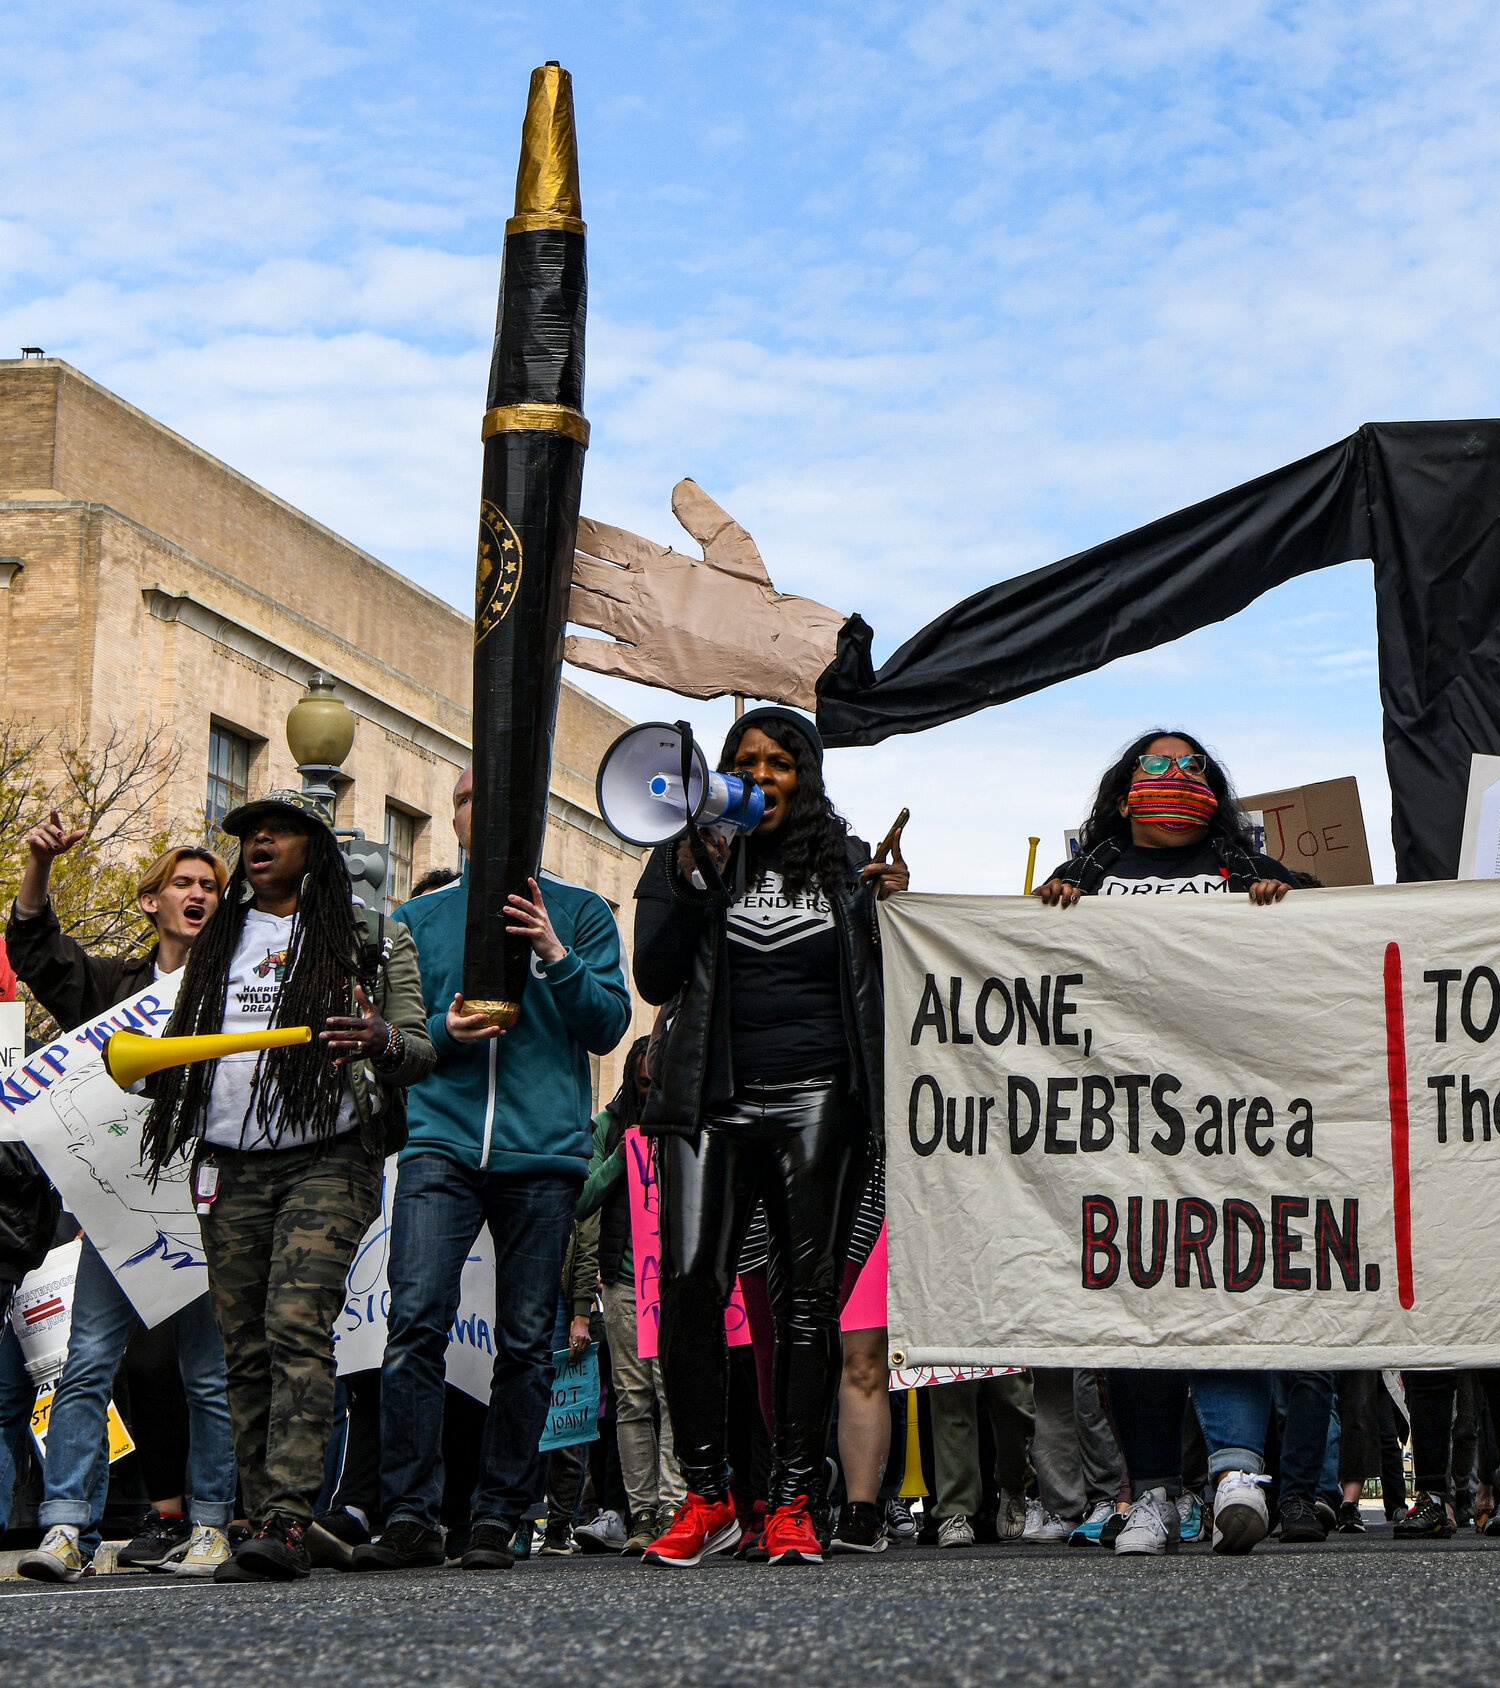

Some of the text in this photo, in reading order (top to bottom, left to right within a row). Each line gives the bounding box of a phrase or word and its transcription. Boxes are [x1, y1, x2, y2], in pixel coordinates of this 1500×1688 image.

[1263, 804, 1349, 862] JOE
[241, 1004, 273, 1012] DREA
[243, 985, 280, 993] HARRIE
[910, 972, 1093, 1057] ALONE,
[0, 1044, 70, 1115] KEEP
[908, 1073, 1314, 1158] Our DEBTS are a
[1081, 1195, 1381, 1293] BURDEN.
